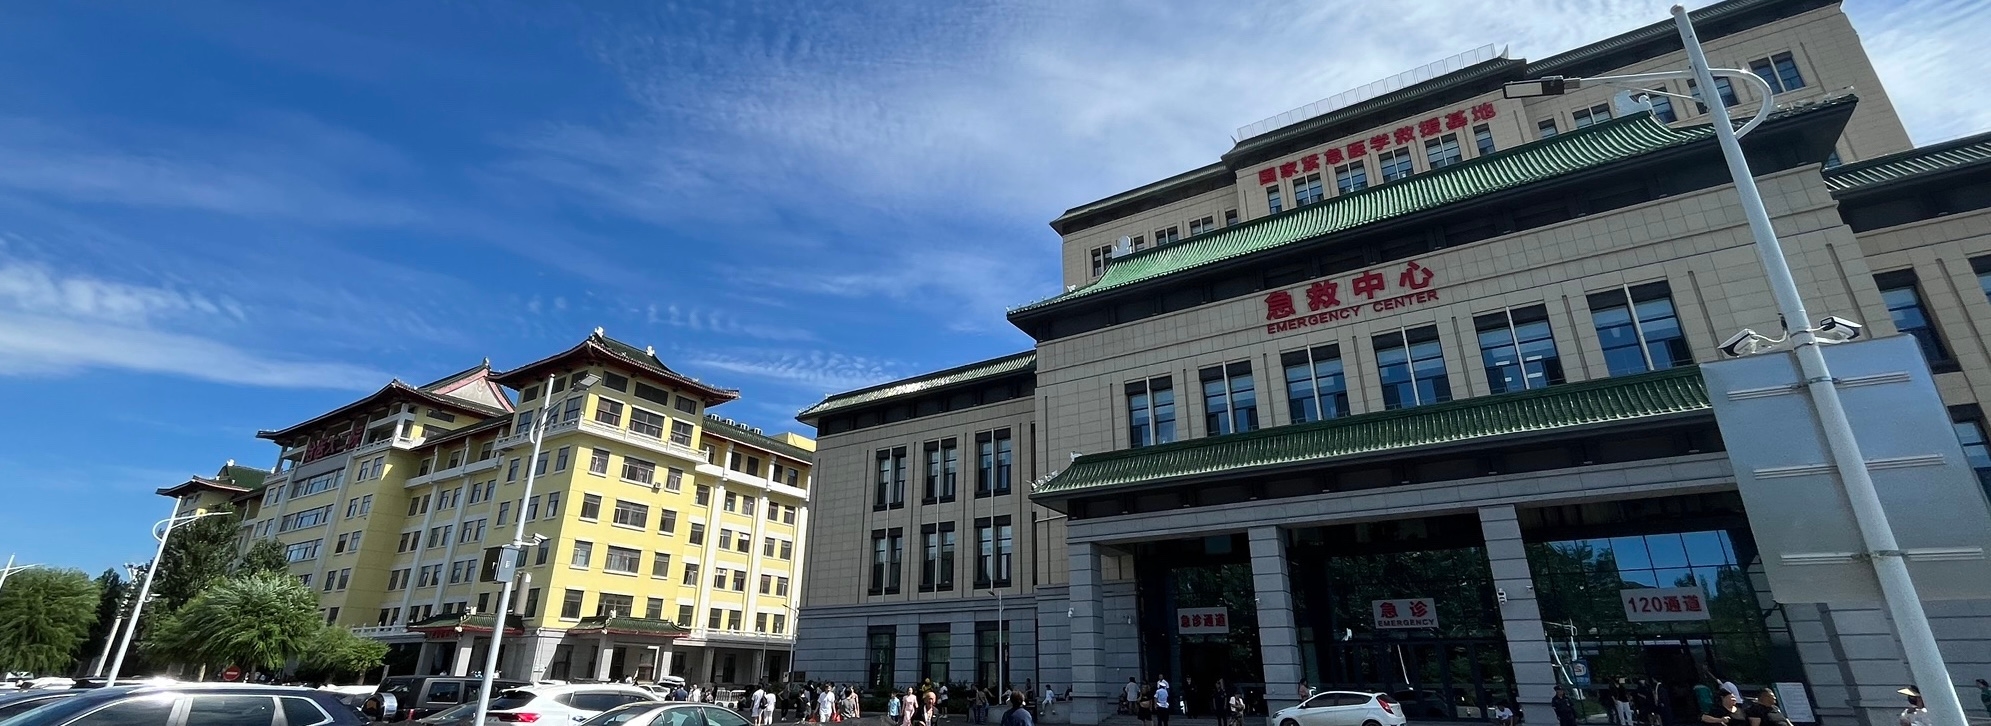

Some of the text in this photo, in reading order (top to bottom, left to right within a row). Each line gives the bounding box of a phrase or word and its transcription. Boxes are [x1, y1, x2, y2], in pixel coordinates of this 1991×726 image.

[1258, 102, 1496, 185] 国家紧急医学救援基地
[1264, 260, 1434, 321] 急救中心
[1267, 289, 1439, 334] EMERGENCY CENTER
[1380, 601, 1427, 618] 急诊
[1628, 595, 1702, 612] 120通道
[1181, 613, 1225, 627] 急诊通道
[1378, 619, 1434, 627] EMERGENCY
